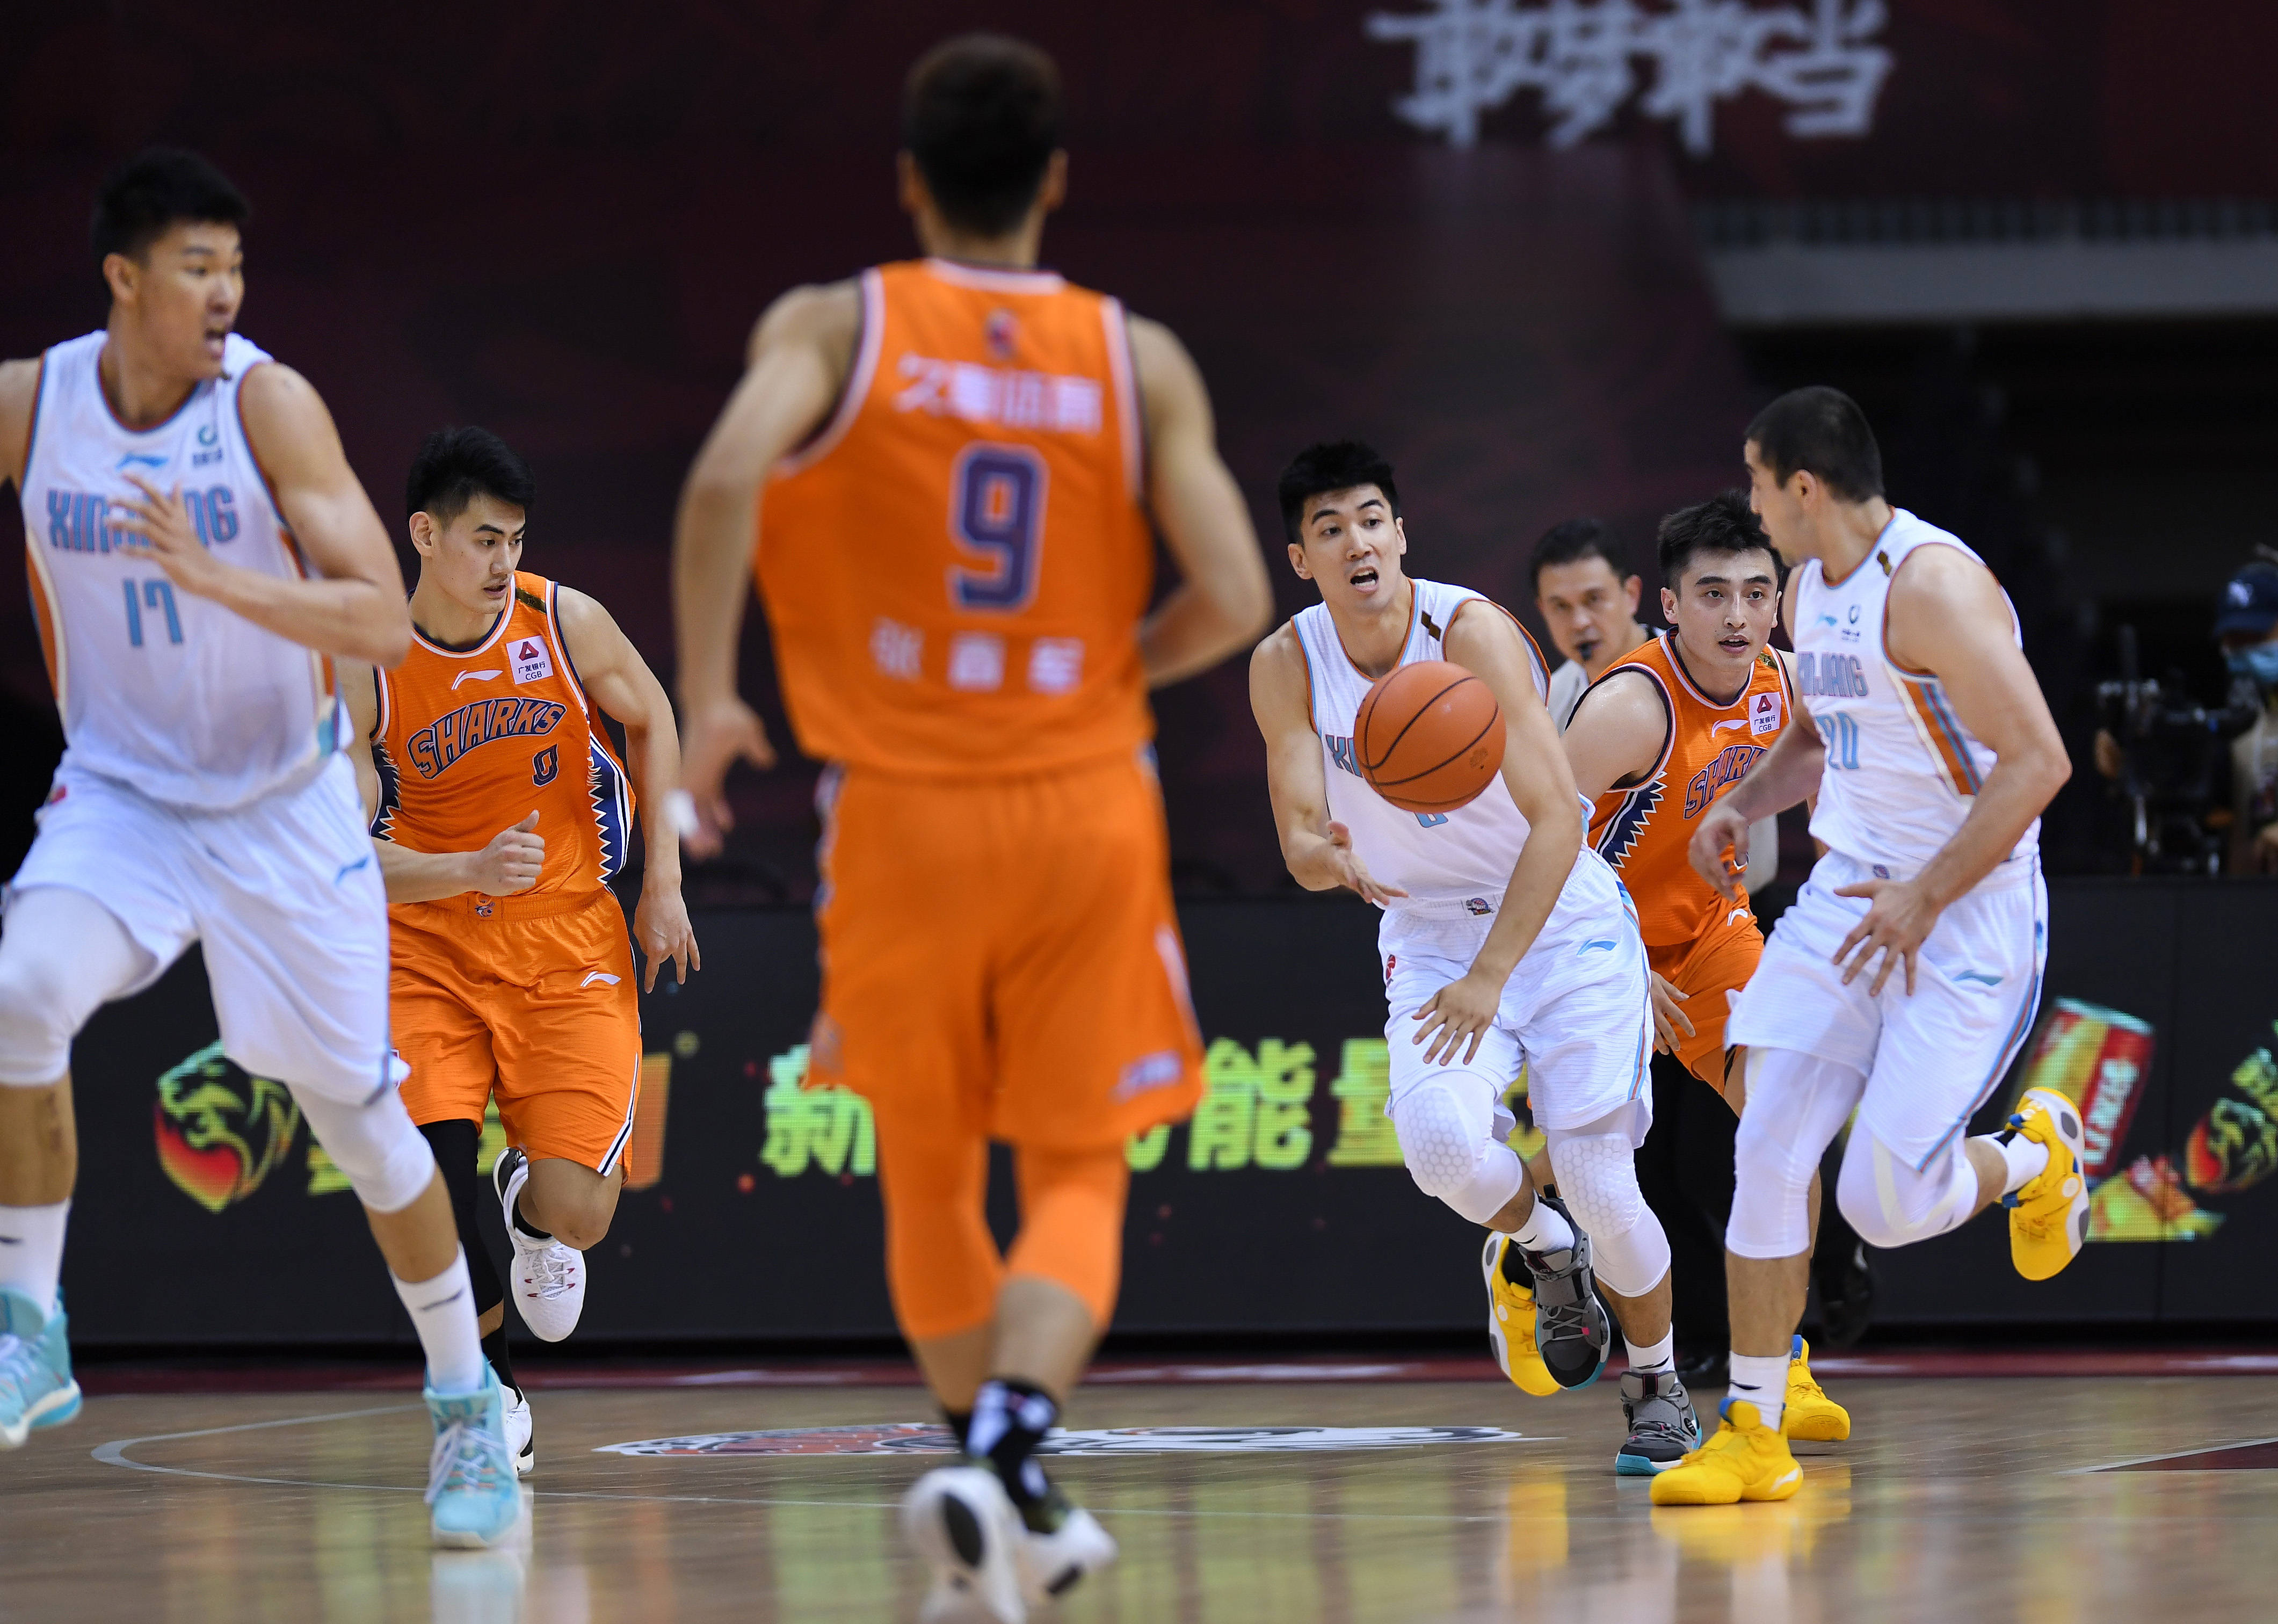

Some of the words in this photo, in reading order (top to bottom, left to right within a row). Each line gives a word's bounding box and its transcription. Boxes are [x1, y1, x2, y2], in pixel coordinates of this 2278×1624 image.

[946, 440, 1050, 617] 9
[122, 578, 185, 647] 17
[518, 661, 546, 675] 广发银行
[525, 670, 543, 680] CGB
[1754, 715, 1776, 726] 广发银行
[1759, 723, 1772, 732] CGB
[407, 697, 567, 780] SHARKS
[532, 743, 559, 787] 0
